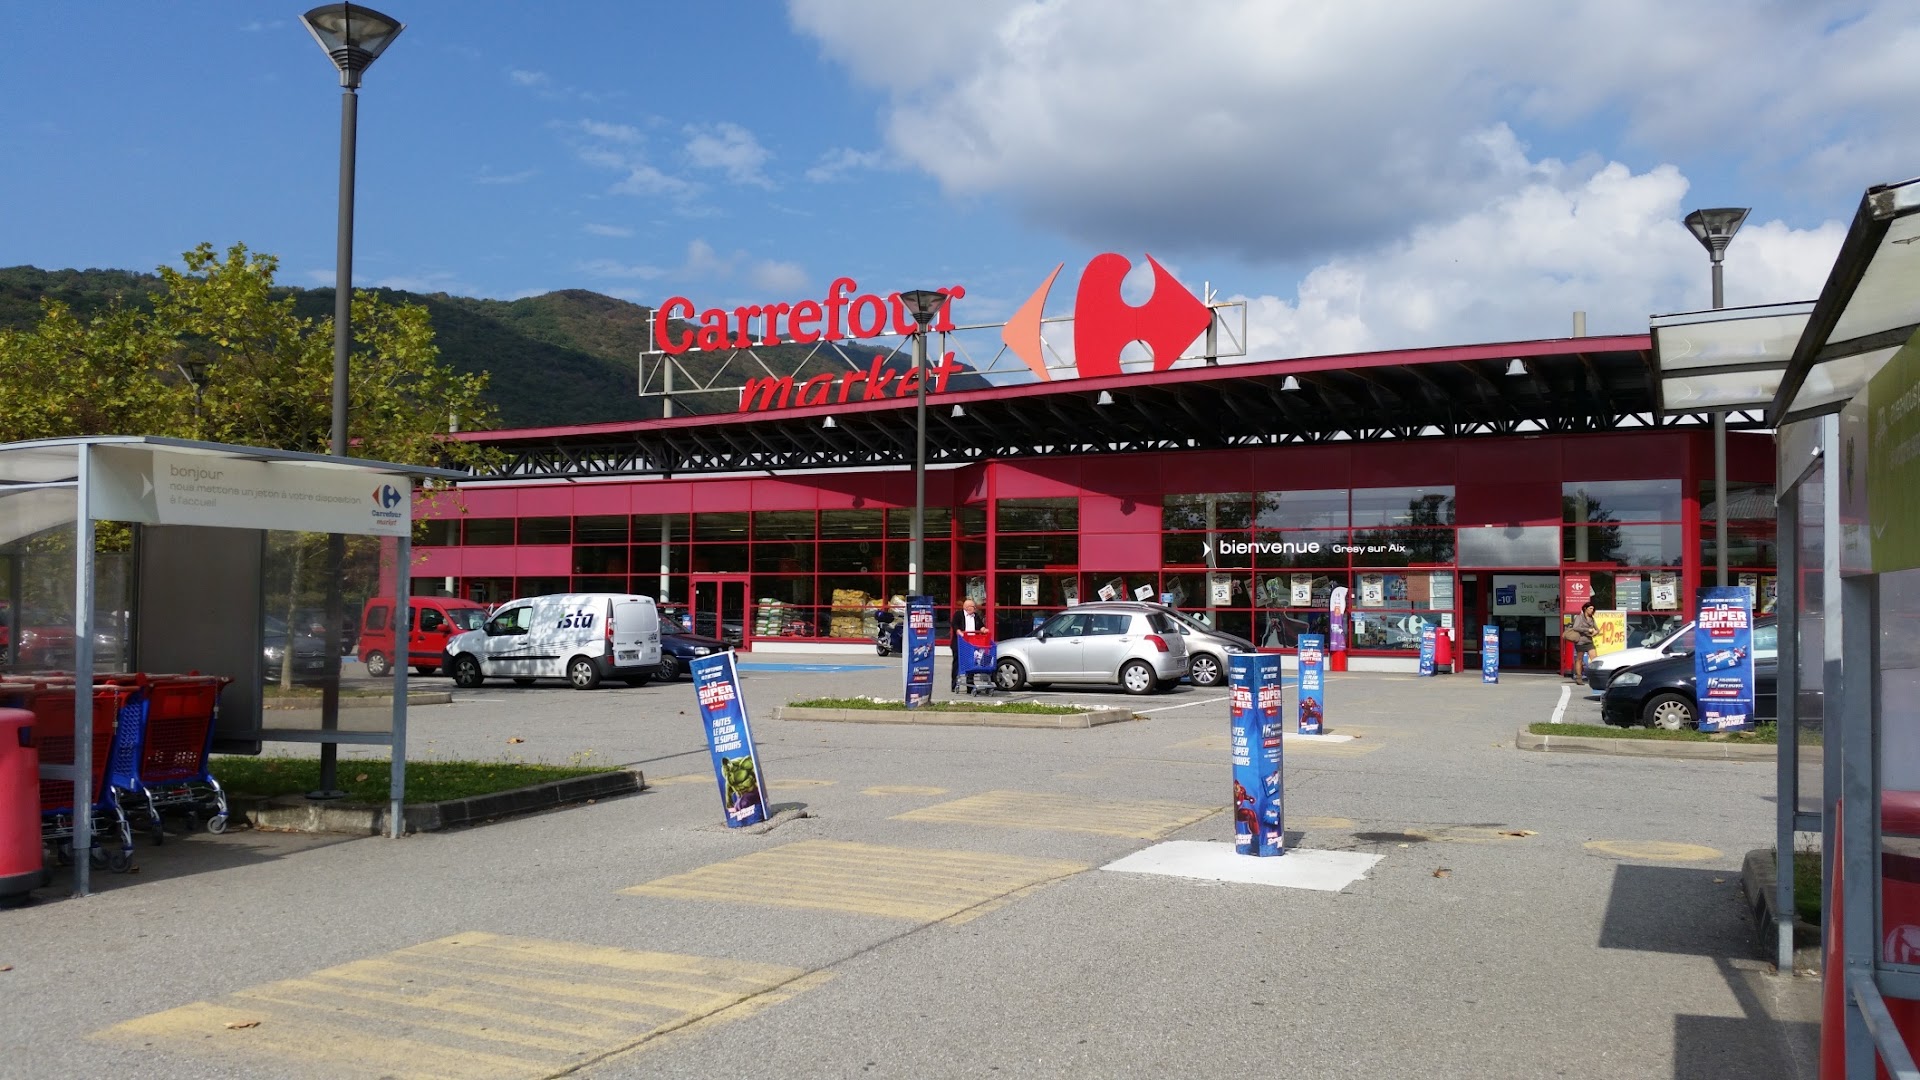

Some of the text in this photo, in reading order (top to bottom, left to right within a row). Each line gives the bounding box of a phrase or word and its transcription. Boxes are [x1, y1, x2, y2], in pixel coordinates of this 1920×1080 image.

[655, 277, 965, 354] Carrefour
[738, 351, 963, 412] market
[170, 464, 224, 481] bonjour
[169, 482, 195, 492] nous
[196, 484, 240, 495] mettons
[241, 488, 254, 496] un
[254, 488, 280, 499] jeton
[289, 491, 314, 501] votre
[315, 493, 362, 506] disposition
[177, 495, 217, 507] l'accueil
[371, 509, 402, 518] Carrefour
[1219, 539, 1320, 555] bienvenue
[1332, 543, 1406, 555] Gresy sur Aix
[557, 609, 594, 629] ista
[910, 615, 933, 623] SUPER
[1699, 611, 1747, 621] SUPER
[707, 681, 718, 689] LA
[1707, 677, 1719, 688] 16
[699, 684, 734, 699] SUPER
[1258, 689, 1281, 701] SUPER
[1262, 724, 1271, 738] 16
